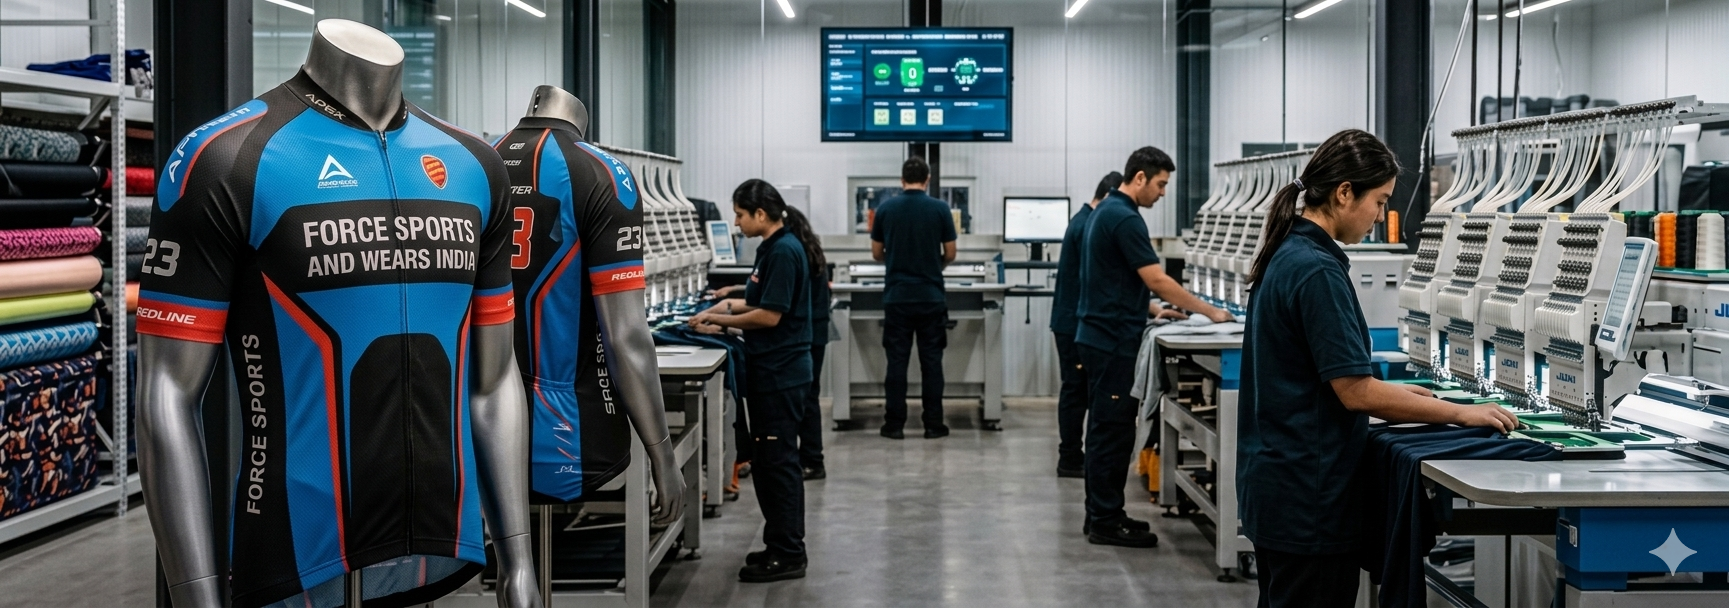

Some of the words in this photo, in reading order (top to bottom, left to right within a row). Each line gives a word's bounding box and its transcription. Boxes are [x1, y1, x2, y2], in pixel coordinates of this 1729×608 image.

[305, 93, 347, 120] APEX
[303, 216, 390, 248] FORCE
[394, 216, 475, 244] SPORTS
[616, 226, 642, 252] 23
[141, 238, 181, 277] 23
[307, 252, 355, 278] AND
[360, 248, 431, 272] WEARS
[436, 249, 476, 272] INDIA
[136, 306, 197, 325] REDLINE
[241, 334, 268, 429] SPORTS
[246, 435, 267, 515] FORCE
